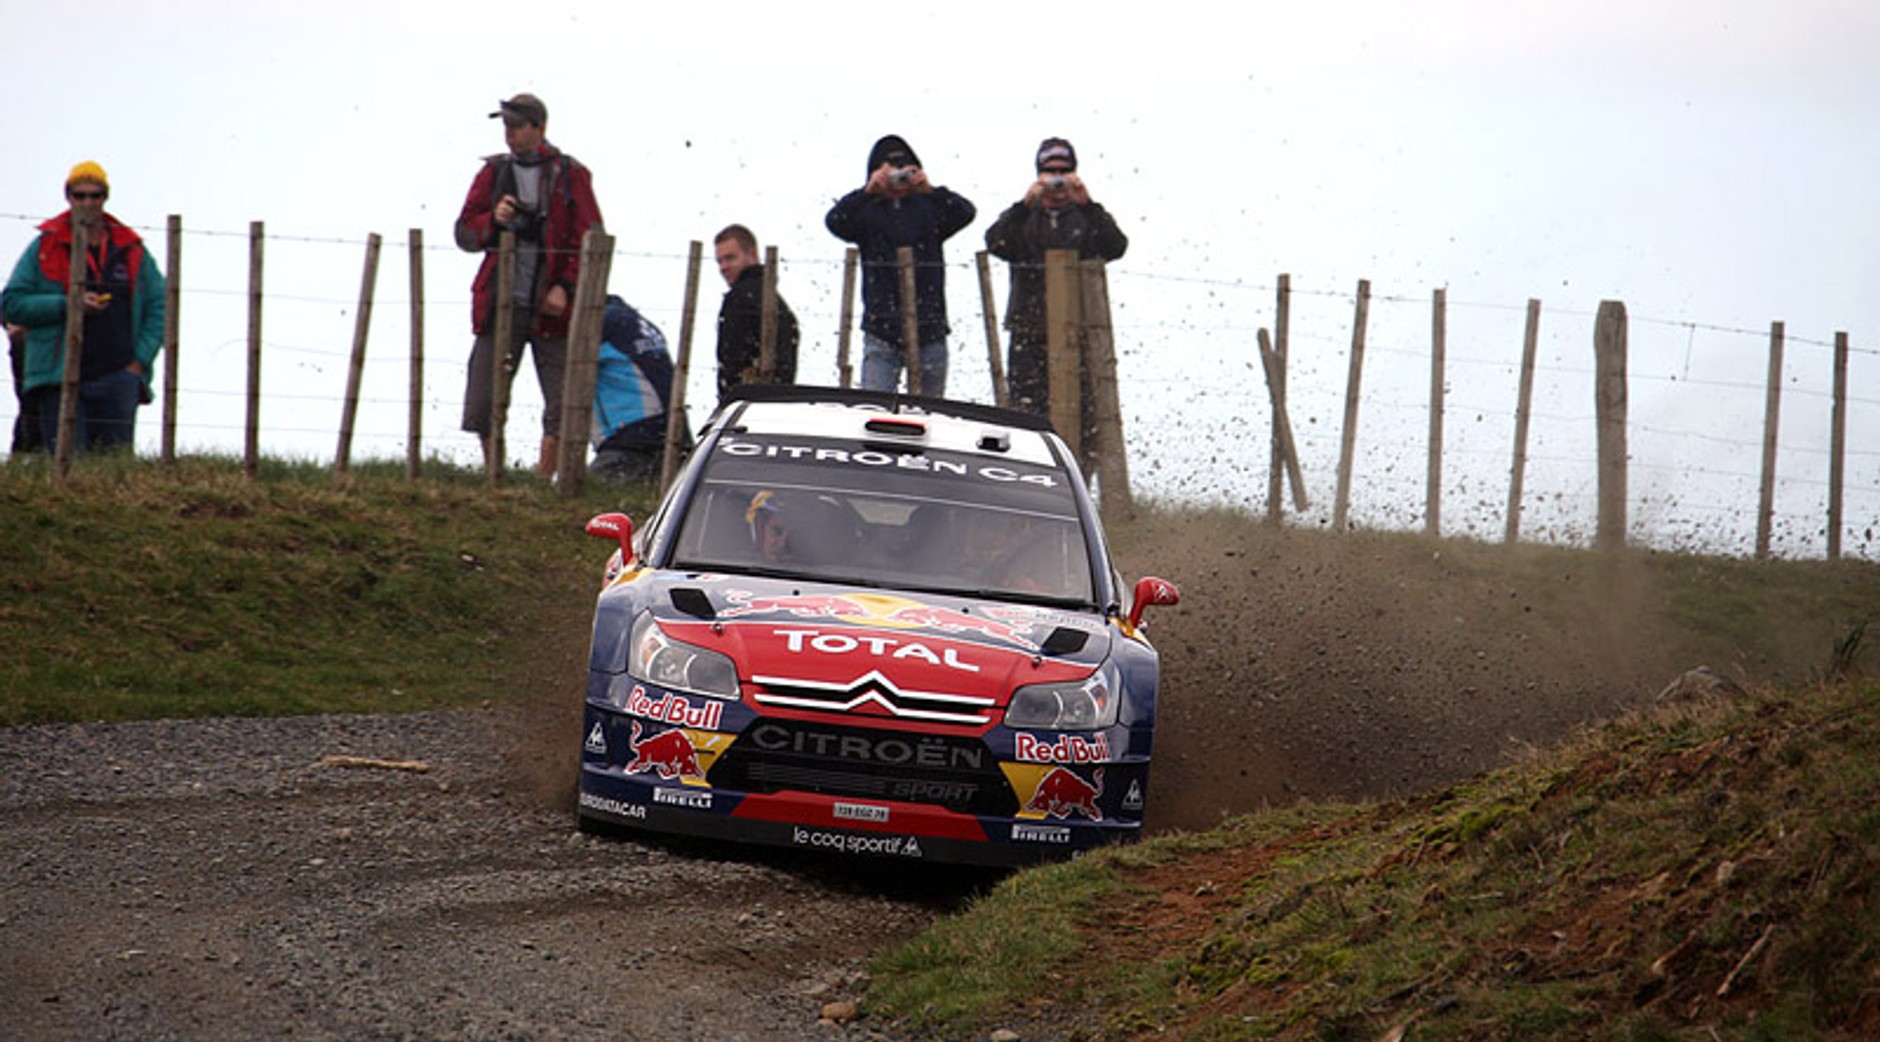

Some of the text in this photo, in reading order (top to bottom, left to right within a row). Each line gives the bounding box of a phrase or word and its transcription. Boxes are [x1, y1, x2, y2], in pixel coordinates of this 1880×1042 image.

[721, 443, 1057, 487] CITROËN C4
[773, 629, 980, 672] TOTAL
[624, 685, 723, 730] Red Bull
[752, 724, 983, 768] CITROËN
[1015, 731, 1112, 763] Red Bull
[653, 786, 713, 808] PIRELLI
[893, 779, 979, 800] SPORT
[794, 825, 902, 853] le coq sportif
[1011, 823, 1071, 843] PIRELLI
